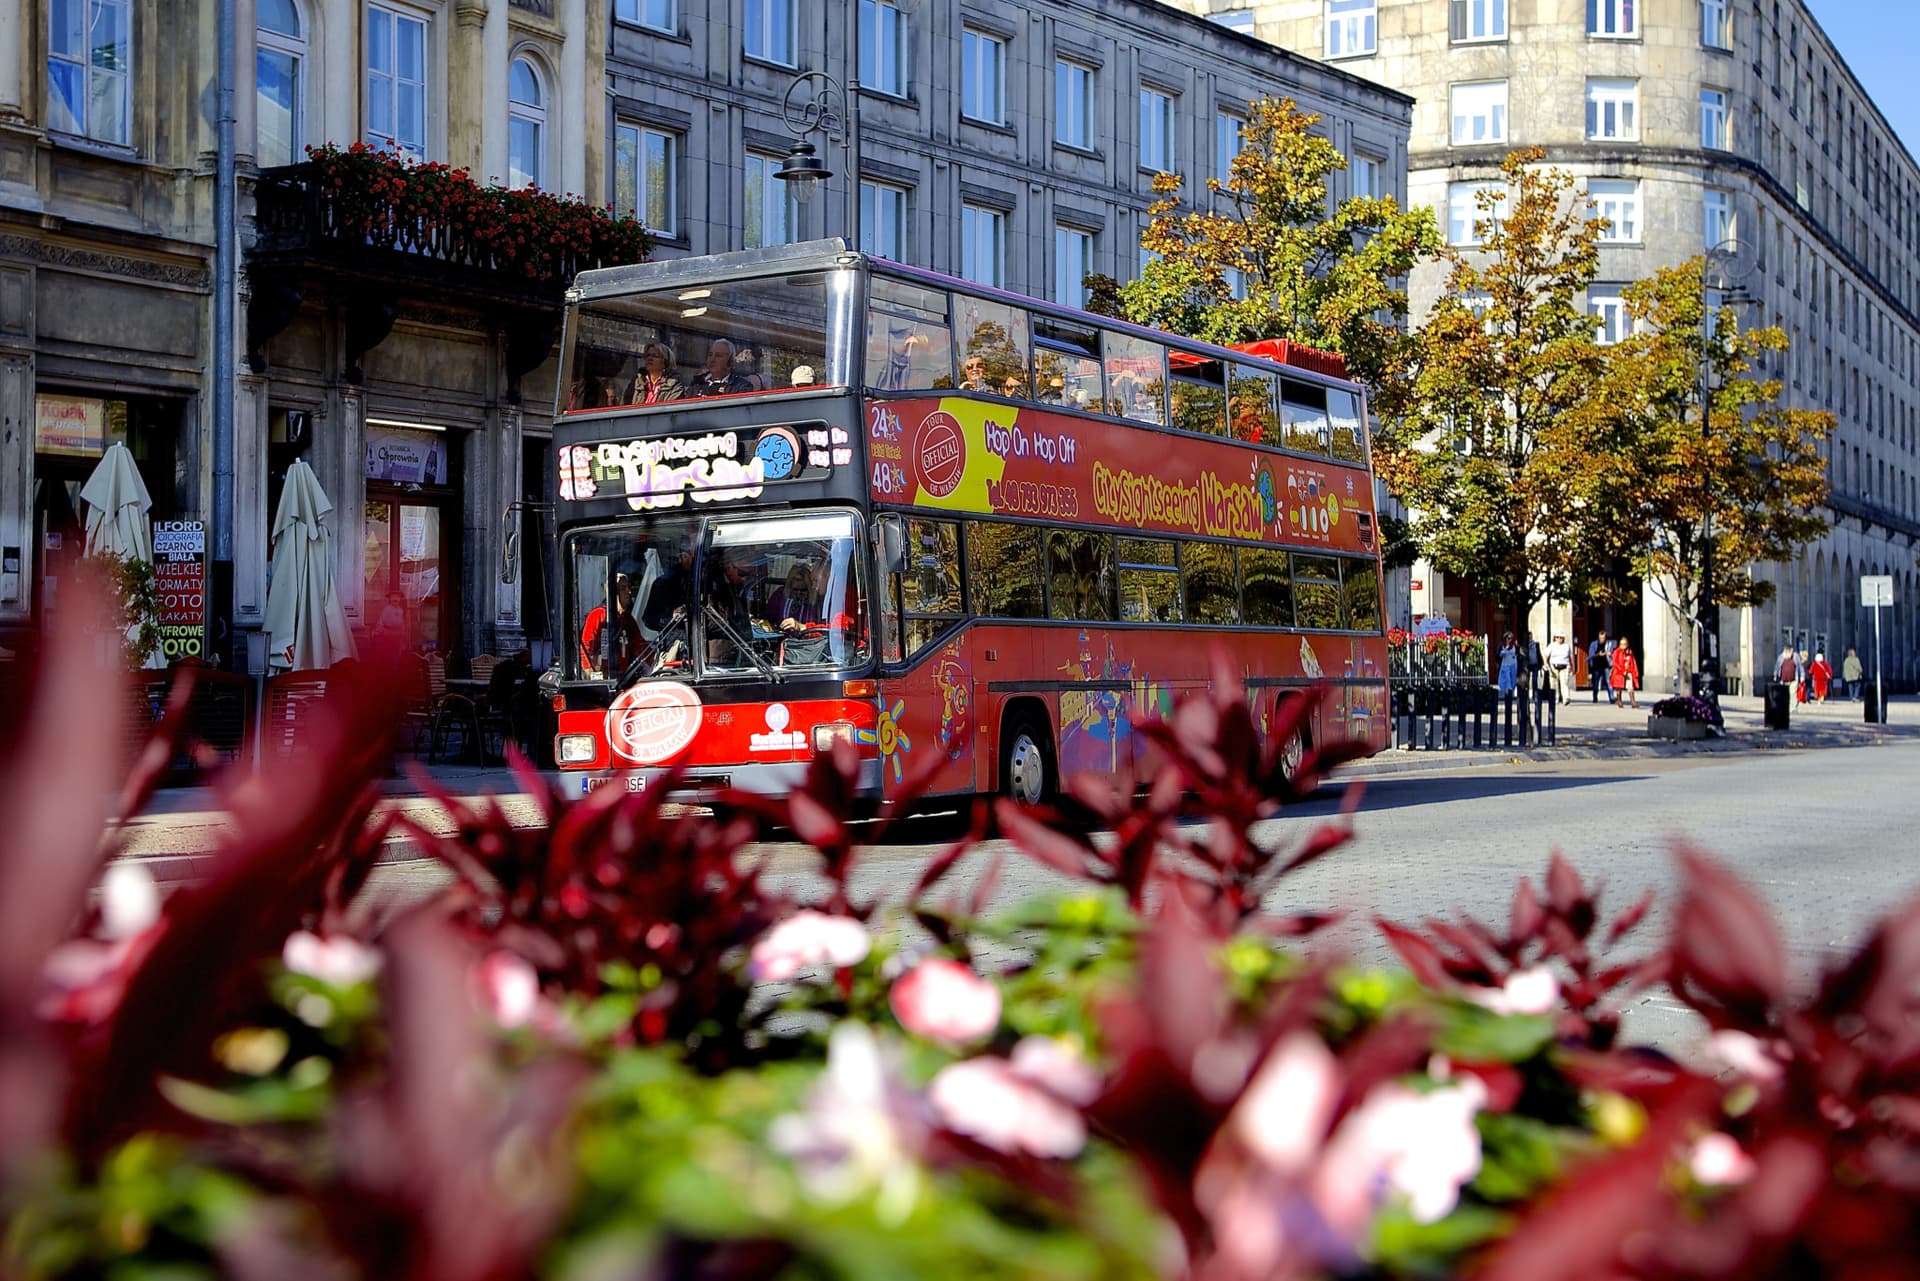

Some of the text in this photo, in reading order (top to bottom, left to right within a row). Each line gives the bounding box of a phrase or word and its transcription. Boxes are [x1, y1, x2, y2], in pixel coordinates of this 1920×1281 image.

[872, 407, 888, 438] 24
[925, 414, 944, 430] TOUR
[985, 422, 1076, 464] Hop On Hop Off
[922, 440, 959, 470] OFFICIAL
[623, 456, 765, 512] Warsaw
[872, 462, 892, 495] 48
[939, 466, 963, 496] WARSAW
[1200, 470, 1264, 541] Warsaw
[154, 520, 204, 532] ILFORD
[153, 532, 204, 542] FOTOGRAFIA
[155, 542, 196, 552] CZARNO
[168, 551, 196, 562] BIAŁA
[155, 562, 202, 576] WIELKIE
[153, 578, 204, 592] FORMATY
[158, 610, 204, 622] LAKATY
[159, 625, 205, 638] YFROWE
[623, 706, 683, 737] OFFICIAL
